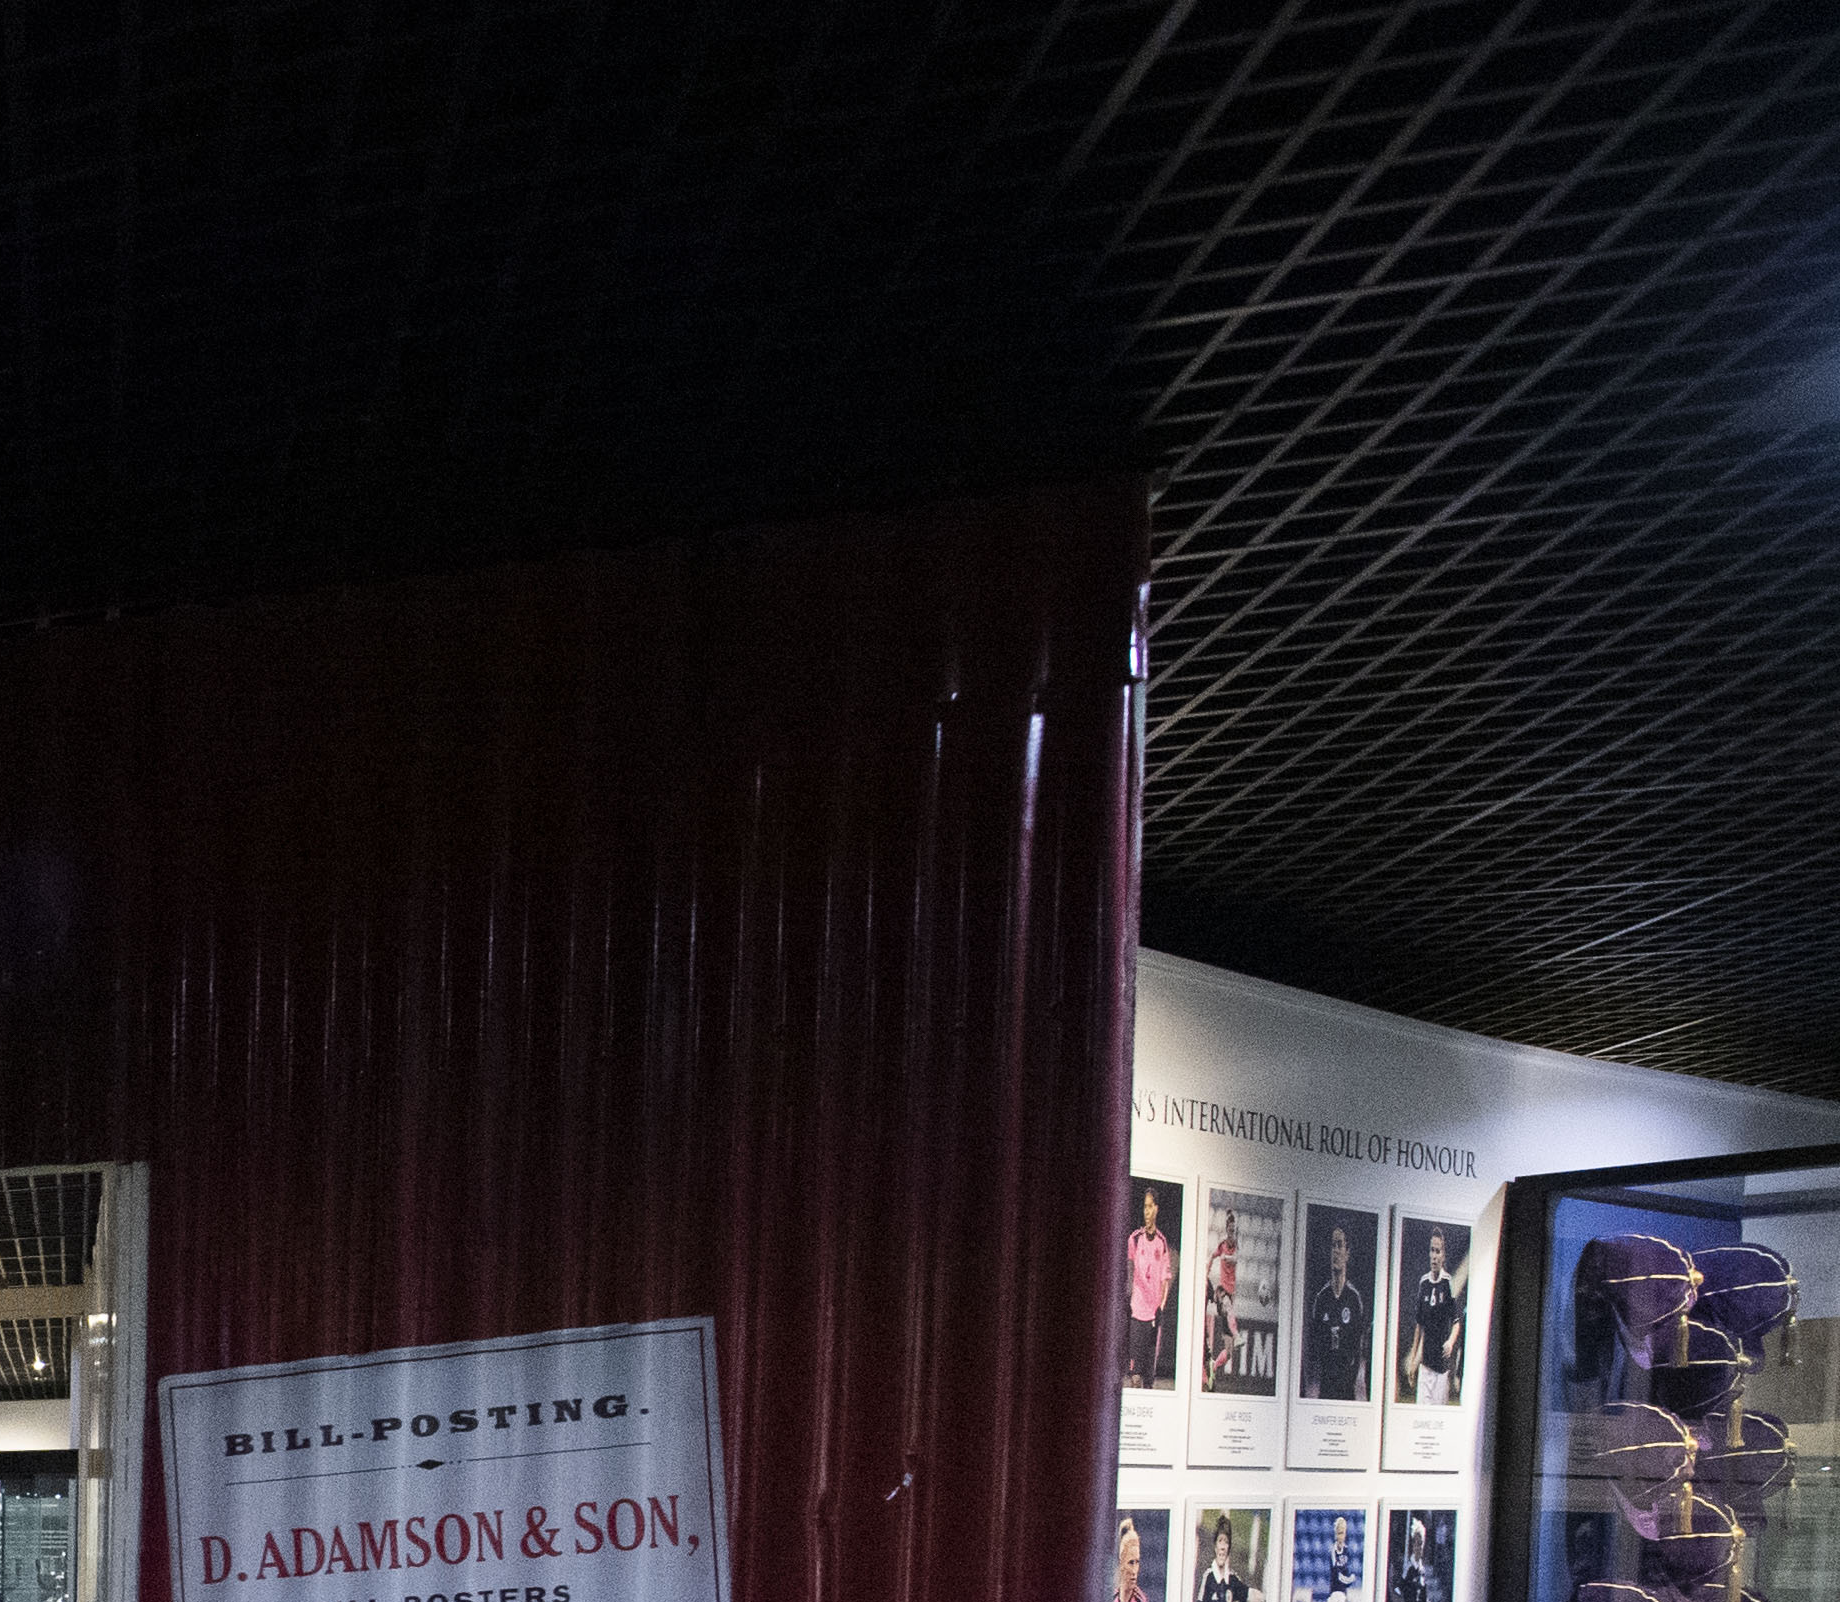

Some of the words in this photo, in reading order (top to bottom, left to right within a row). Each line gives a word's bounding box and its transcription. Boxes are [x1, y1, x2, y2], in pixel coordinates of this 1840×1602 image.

[1163, 1094, 1315, 1152] INTERNATIONAL
[1321, 1125, 1364, 1161] ROLL
[1368, 1134, 1391, 1165] OF
[1396, 1139, 1478, 1179] HONOUR
[224, 1393, 650, 1458] BILL-POSTING.
[256, 1509, 505, 1580] ADAMSON
[519, 1505, 563, 1559] &
[573, 1494, 701, 1557] SON,
